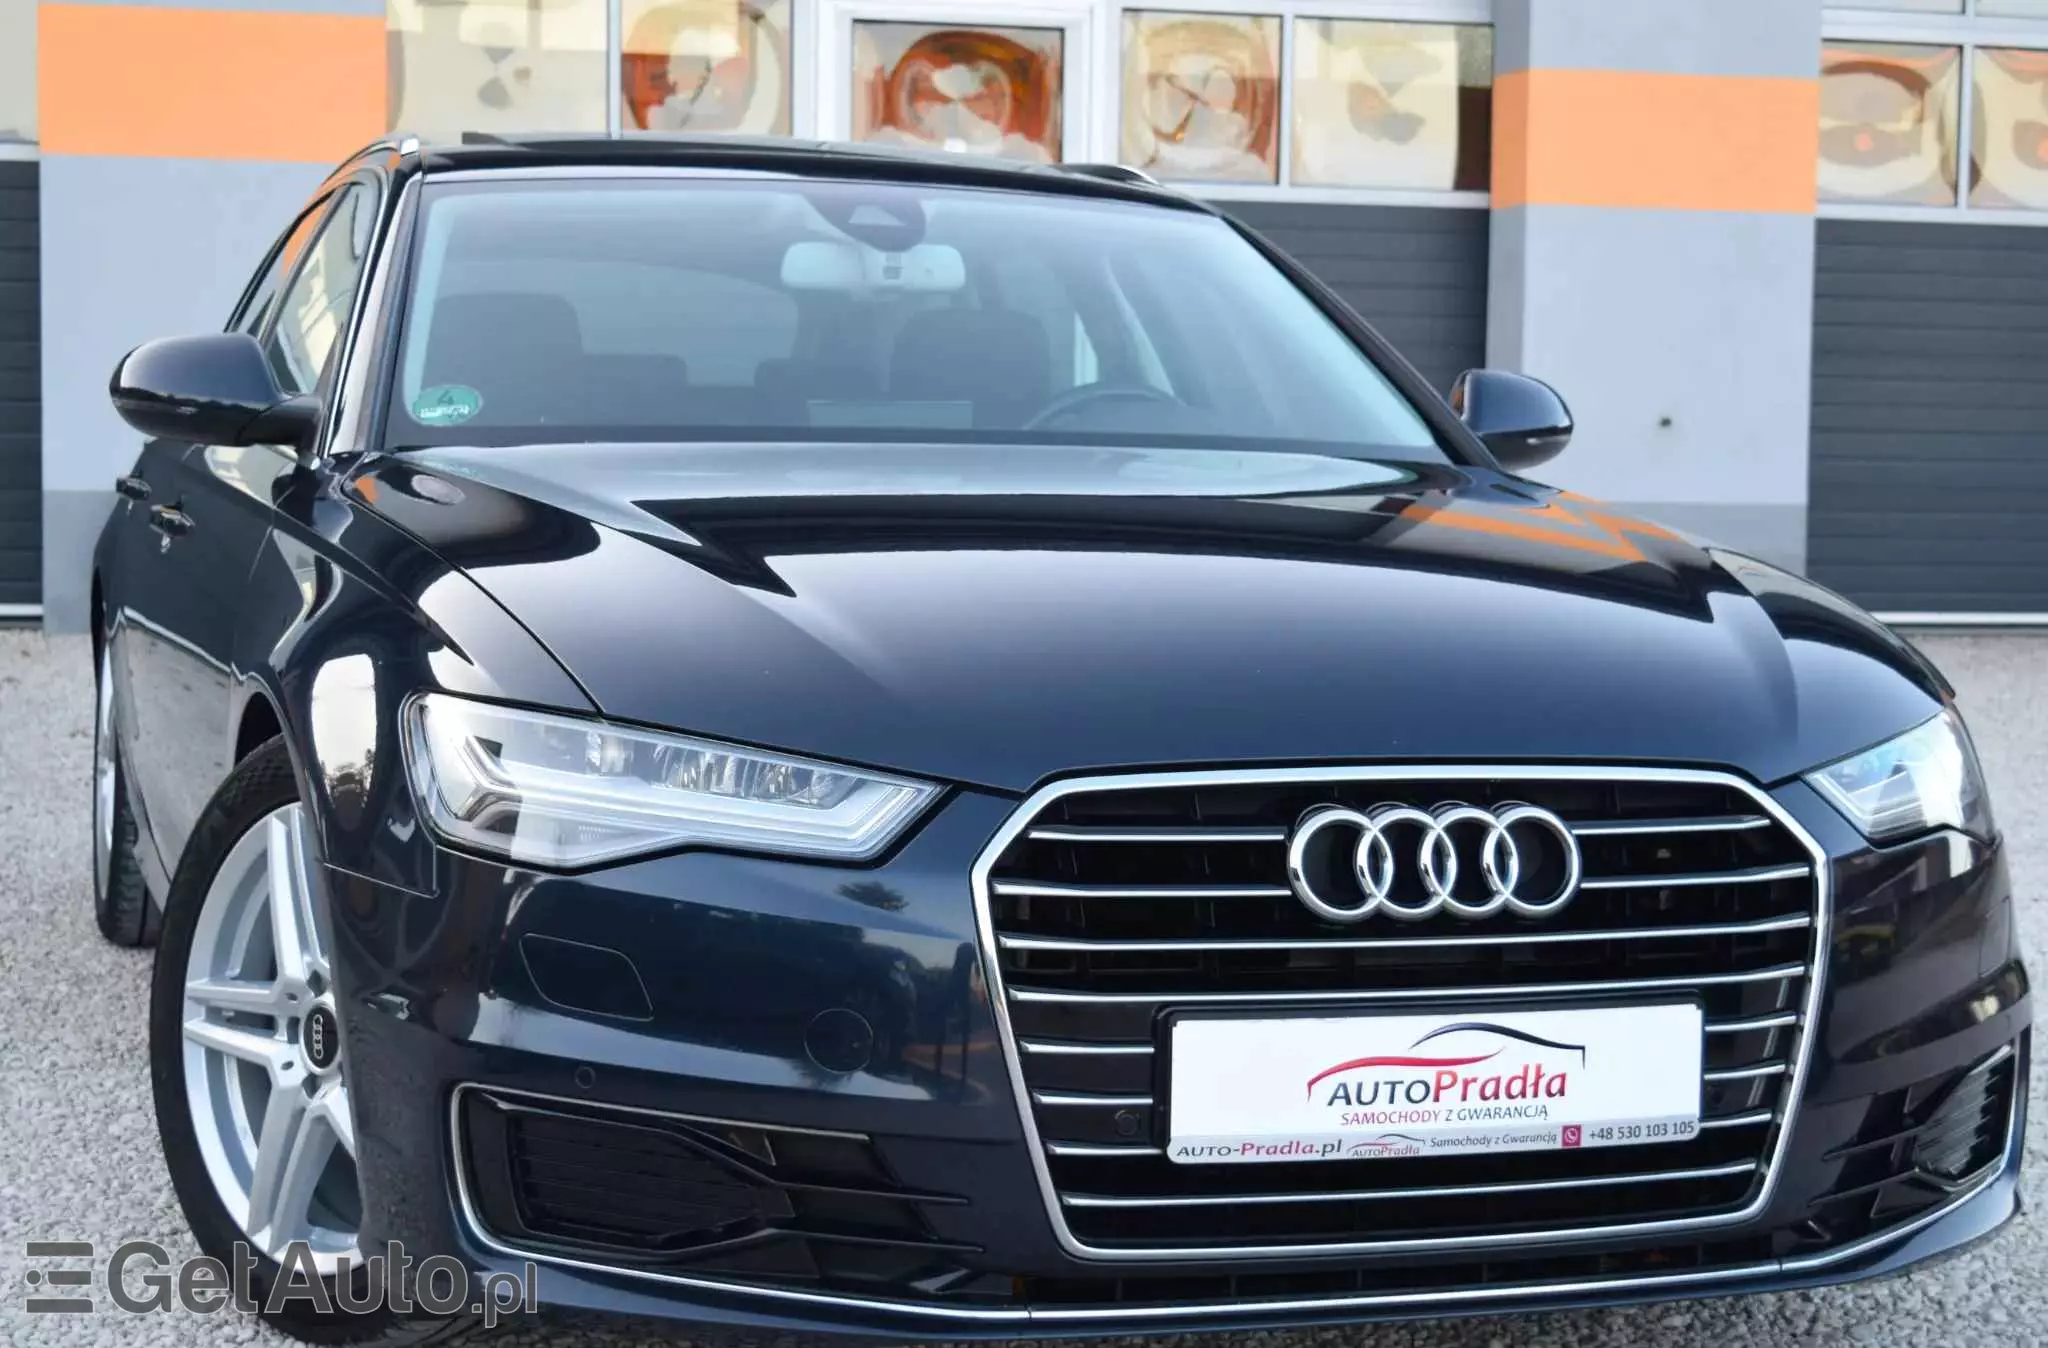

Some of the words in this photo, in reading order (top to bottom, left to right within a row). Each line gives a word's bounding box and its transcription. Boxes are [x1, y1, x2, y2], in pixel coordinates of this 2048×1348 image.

[437, 390, 454, 405] 4
[1327, 1063, 1567, 1106] AUTOPradła
[1341, 1110, 1441, 1126] SAMOCHODY
[1444, 1109, 1453, 1122] Z
[1457, 1104, 1548, 1121] GWARANCJĄ
[1430, 1135, 1492, 1151] Samochody
[1494, 1137, 1501, 1145] z
[1502, 1131, 1558, 1145] Gwarancją
[1589, 1127, 1614, 1141] +48
[1617, 1125, 1641, 1139] 530
[1646, 1123, 1668, 1136] 103
[1672, 1120, 1695, 1135] 105
